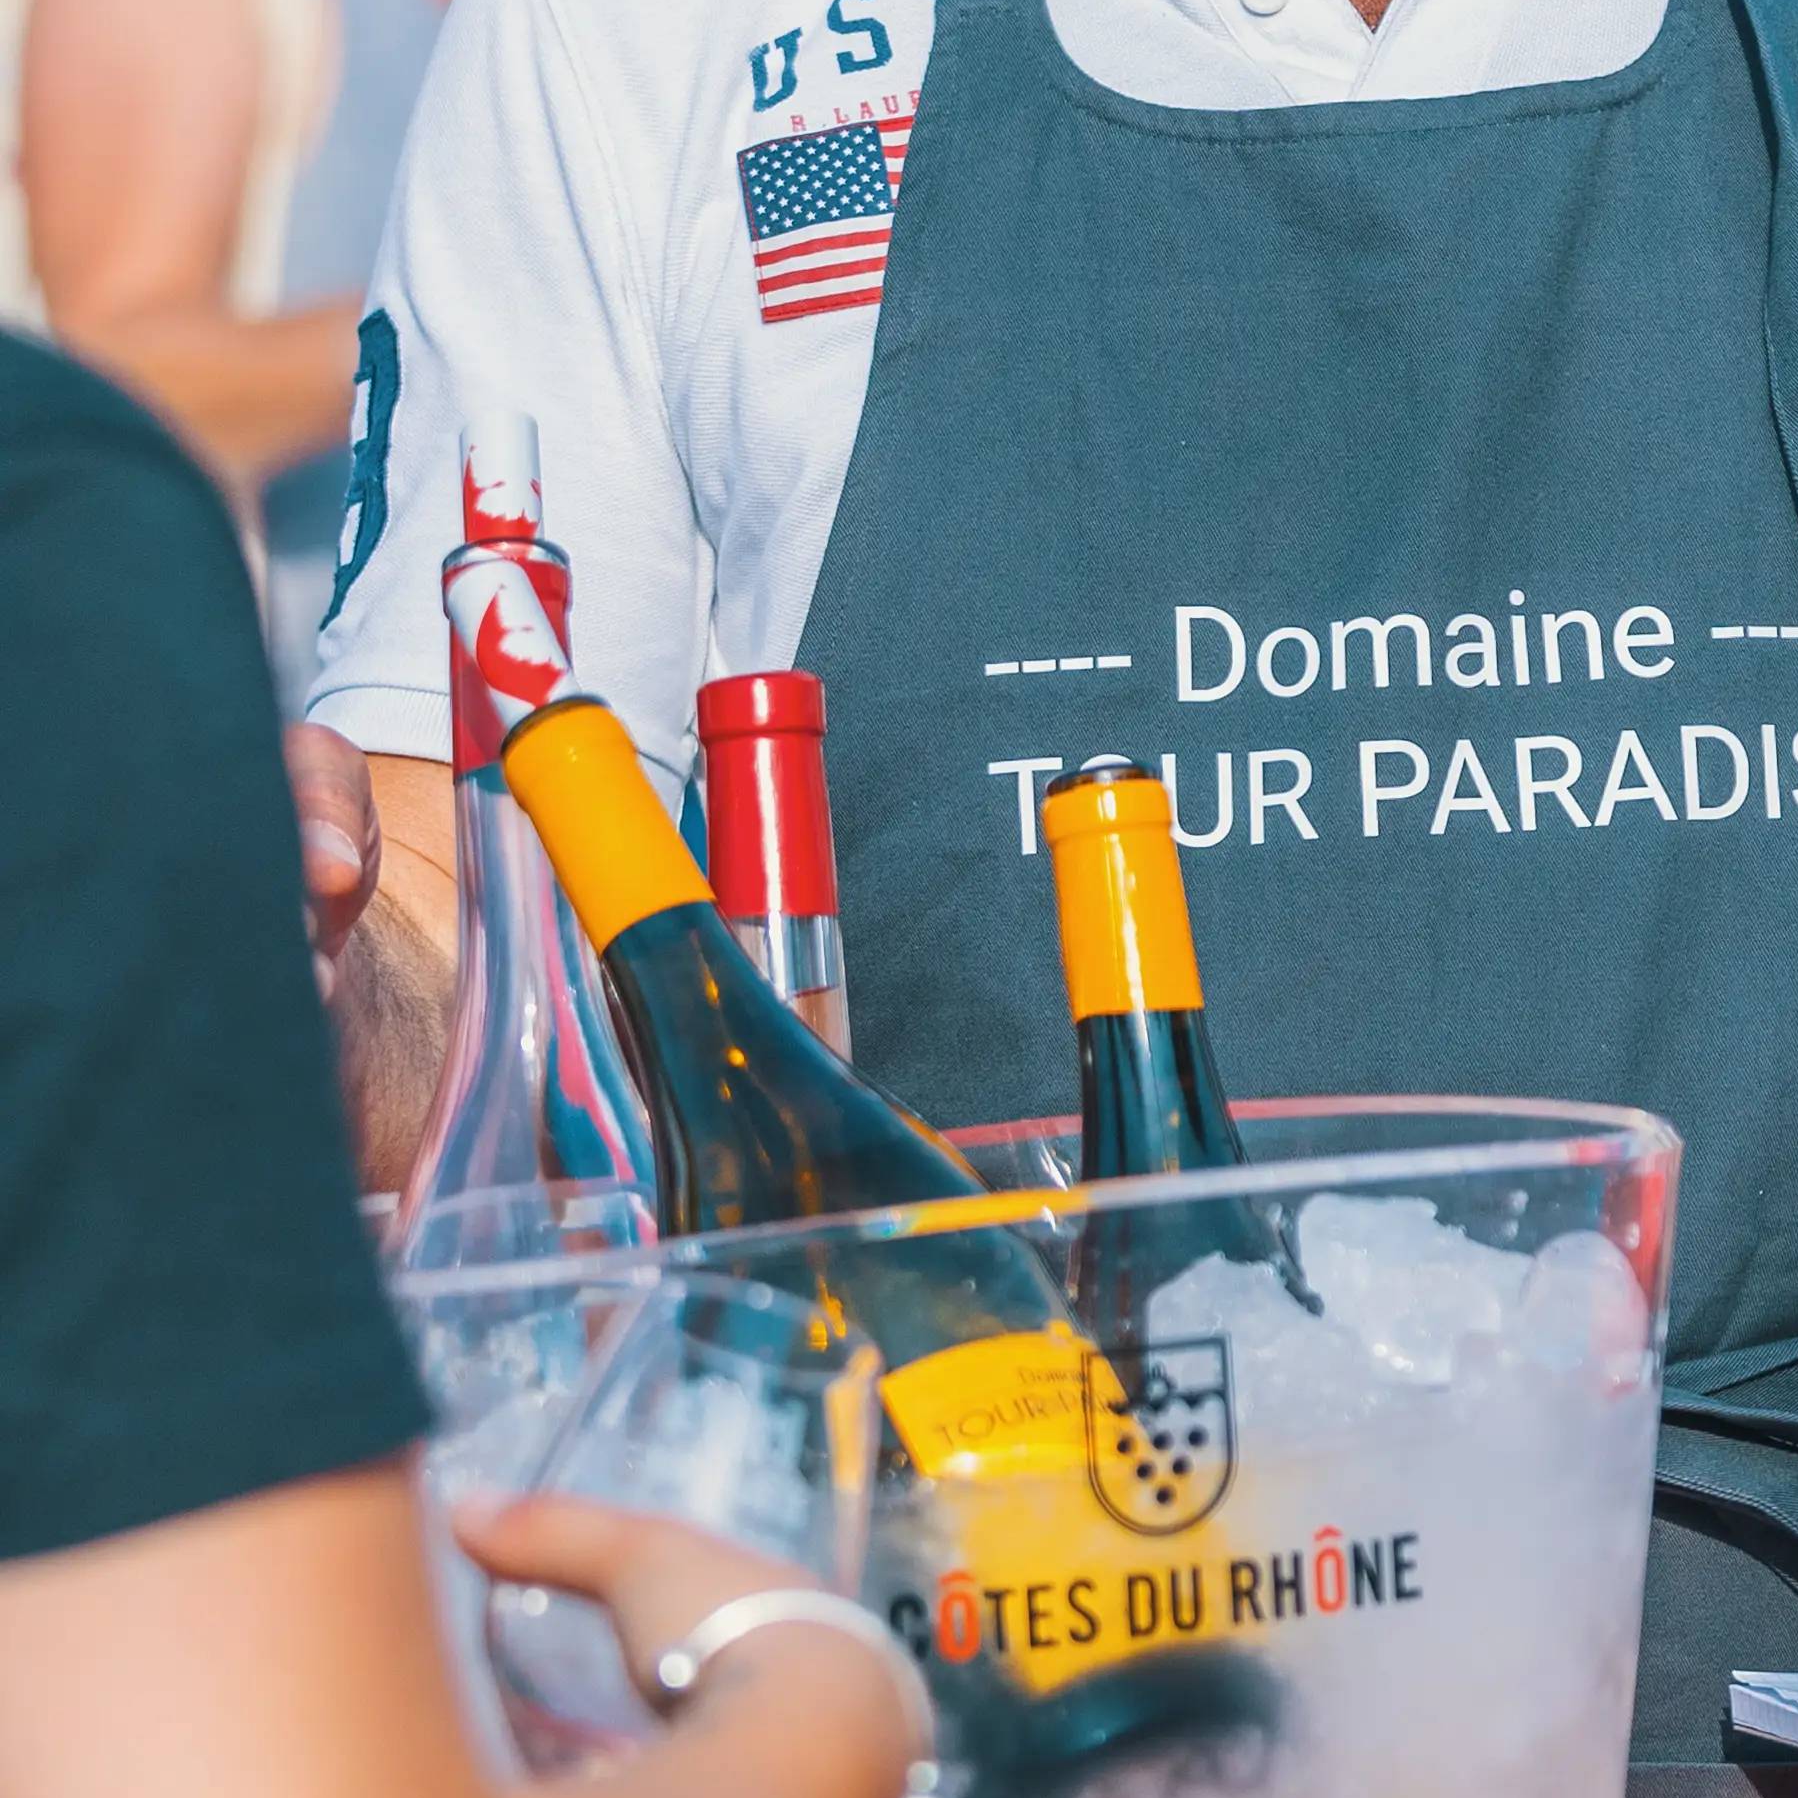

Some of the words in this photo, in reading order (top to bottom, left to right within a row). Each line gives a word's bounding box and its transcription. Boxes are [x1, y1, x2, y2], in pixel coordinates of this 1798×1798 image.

[1174, 589, 1675, 703] Domaine
[987, 748, 1320, 856] TUR
[889, 1569, 1099, 1664] CÔTES
[1126, 1565, 1202, 1639] DU
[1229, 1525, 1423, 1627] RHÔNE
